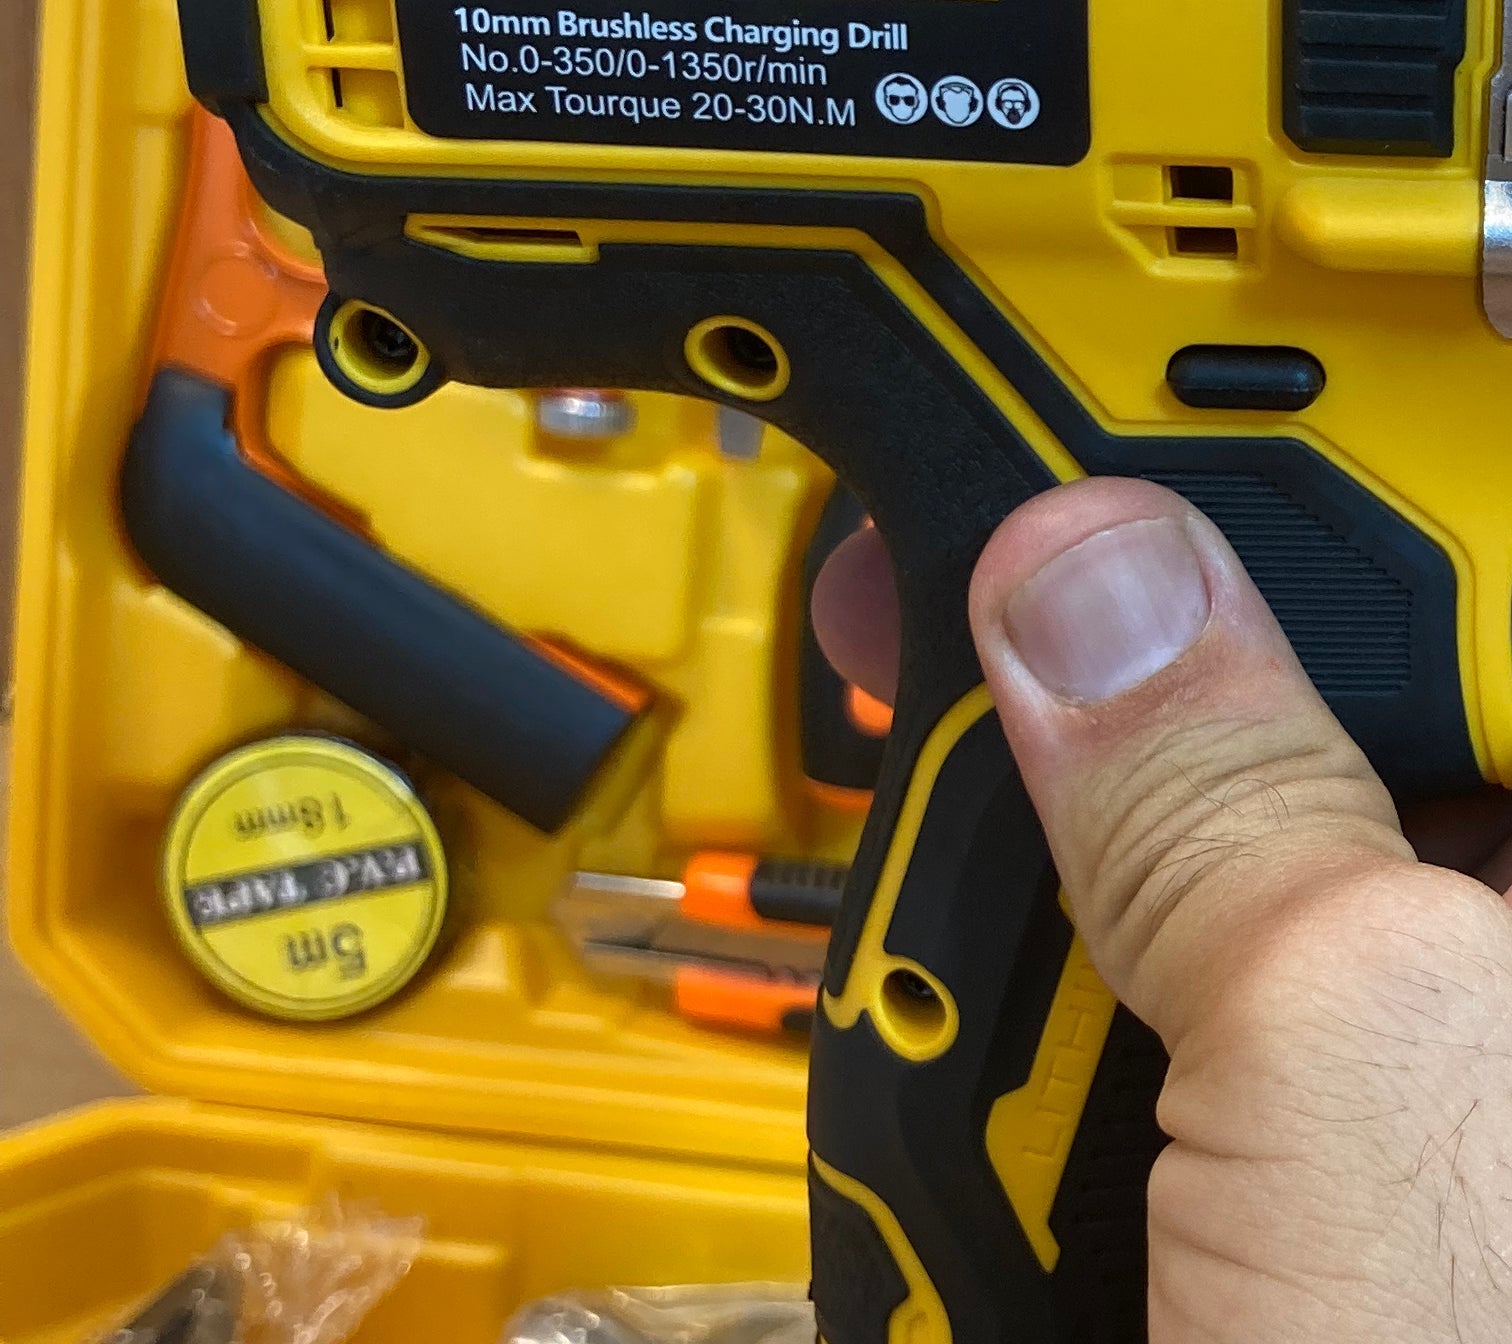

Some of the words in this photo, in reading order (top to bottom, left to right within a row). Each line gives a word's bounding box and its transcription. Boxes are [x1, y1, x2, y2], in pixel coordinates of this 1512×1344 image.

[454, 6, 550, 37] 10mm
[557, 10, 697, 43] Brushless
[704, 17, 840, 54] Charging
[848, 23, 909, 51] Drill
[462, 44, 827, 86] No.0-350/0-1350r/min
[466, 84, 537, 114] Max
[545, 87, 681, 123] Tourque
[692, 93, 857, 127] 20-30N.M
[285, 922, 367, 980] 5m
[1020, 962, 1103, 1160] LITHI
